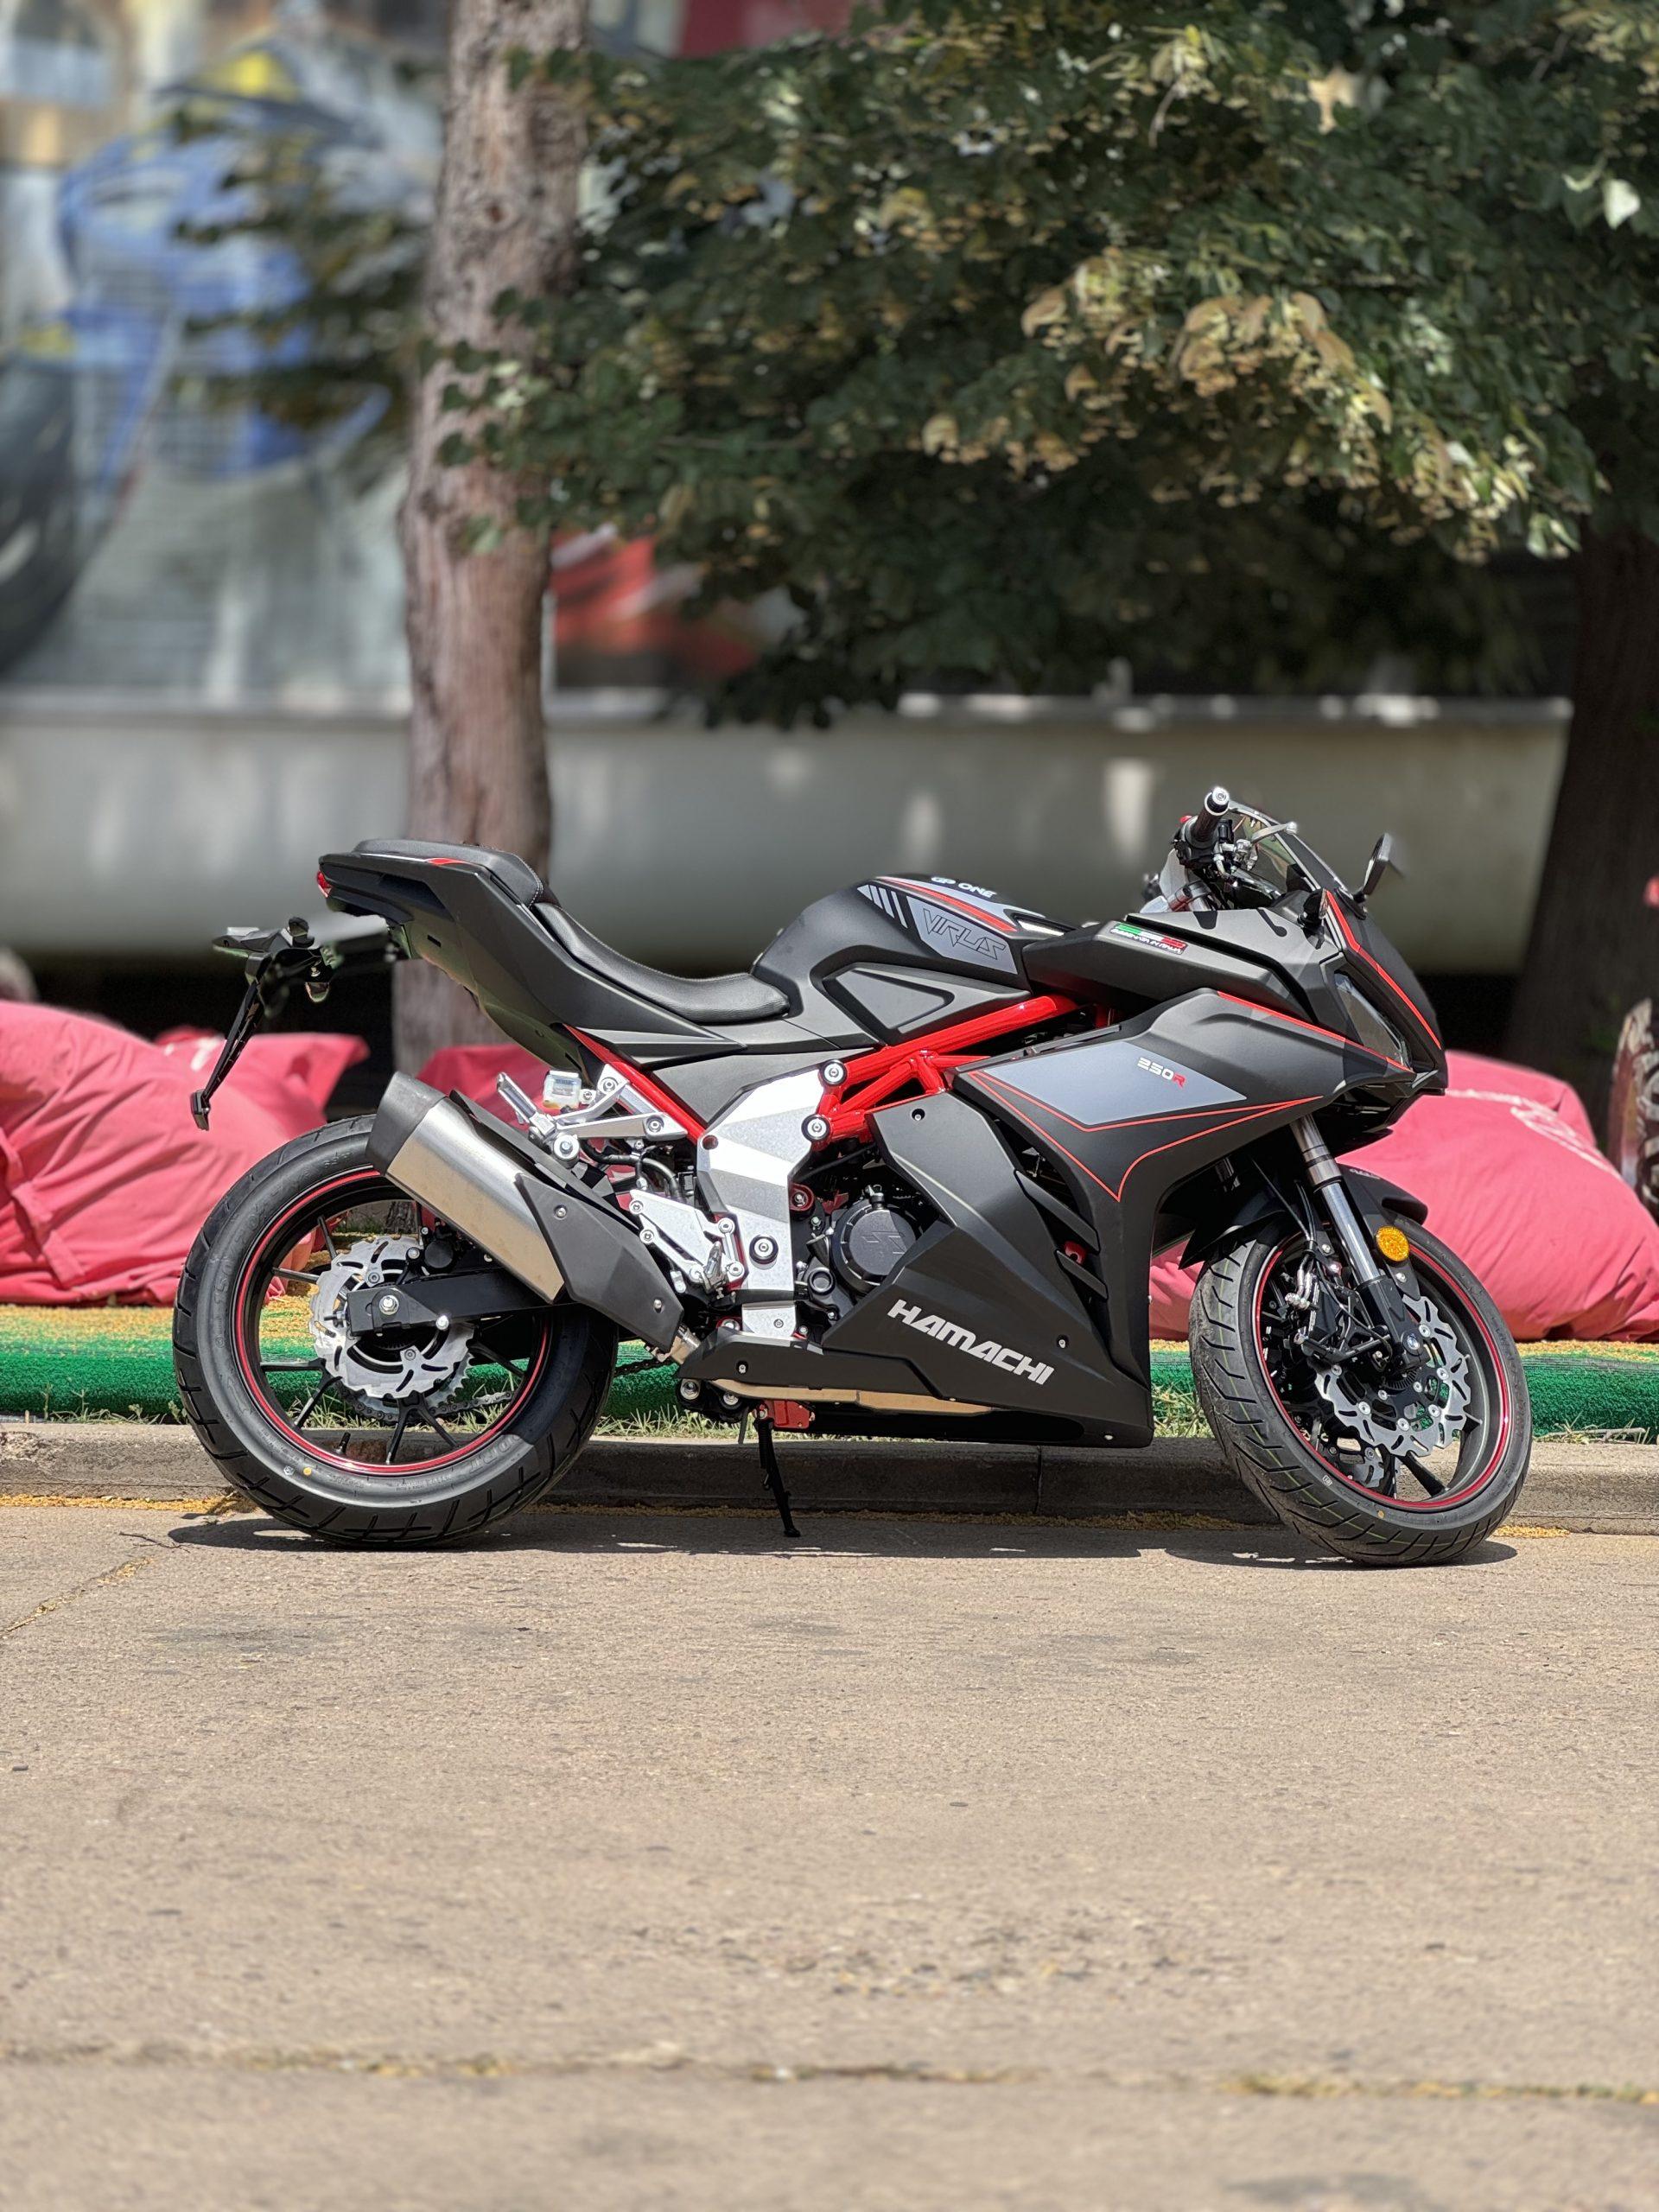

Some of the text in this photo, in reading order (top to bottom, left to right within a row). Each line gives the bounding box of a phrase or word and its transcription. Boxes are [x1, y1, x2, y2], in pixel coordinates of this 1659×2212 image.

[957, 882, 997, 899] ONE
[923, 907, 1007, 961] VIRUS
[1136, 1057, 1186, 1089] 250R
[887, 1299, 1055, 1385] HAMACHI
